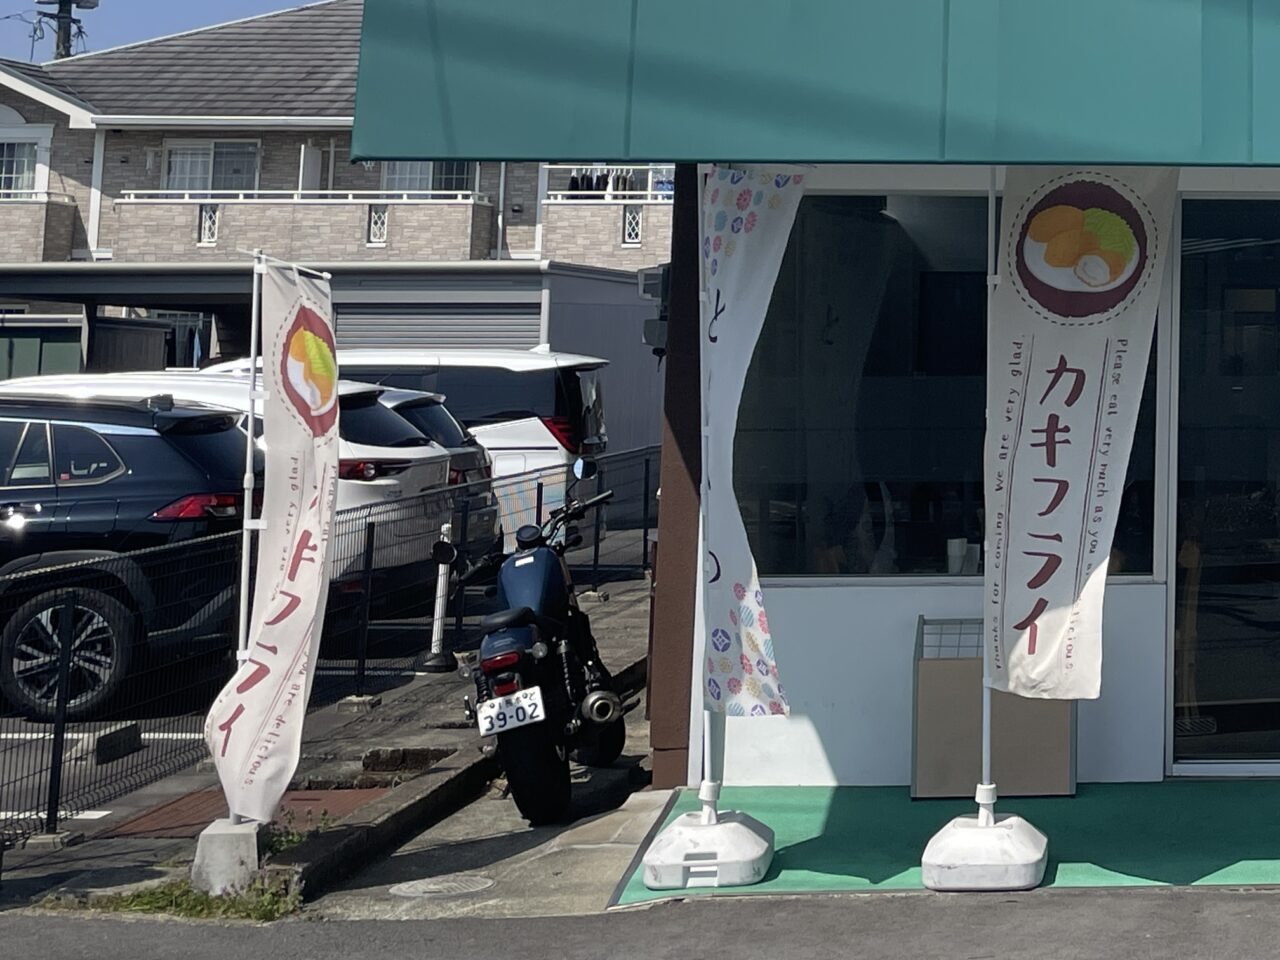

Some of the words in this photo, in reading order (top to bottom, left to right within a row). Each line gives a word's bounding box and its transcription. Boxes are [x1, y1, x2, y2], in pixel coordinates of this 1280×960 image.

[1008, 334, 1025, 377] glad.
[1111, 339, 1128, 385] Please
[1005, 387, 1020, 423] very
[1107, 394, 1118, 416] eat
[998, 433, 1009, 460] are
[1098, 426, 1112, 457] very
[994, 471, 1005, 492] We
[1096, 463, 1109, 497] much
[1013, 354, 1086, 655] カキフライ
[1093, 505, 1104, 523] as
[1088, 529, 1100, 554] you
[991, 581, 1000, 605] for
[217, 494, 319, 759] キフライ
[285, 683, 302, 706] are
[483, 702, 540, 732] 39-02
[242, 714, 286, 791] delicious.
